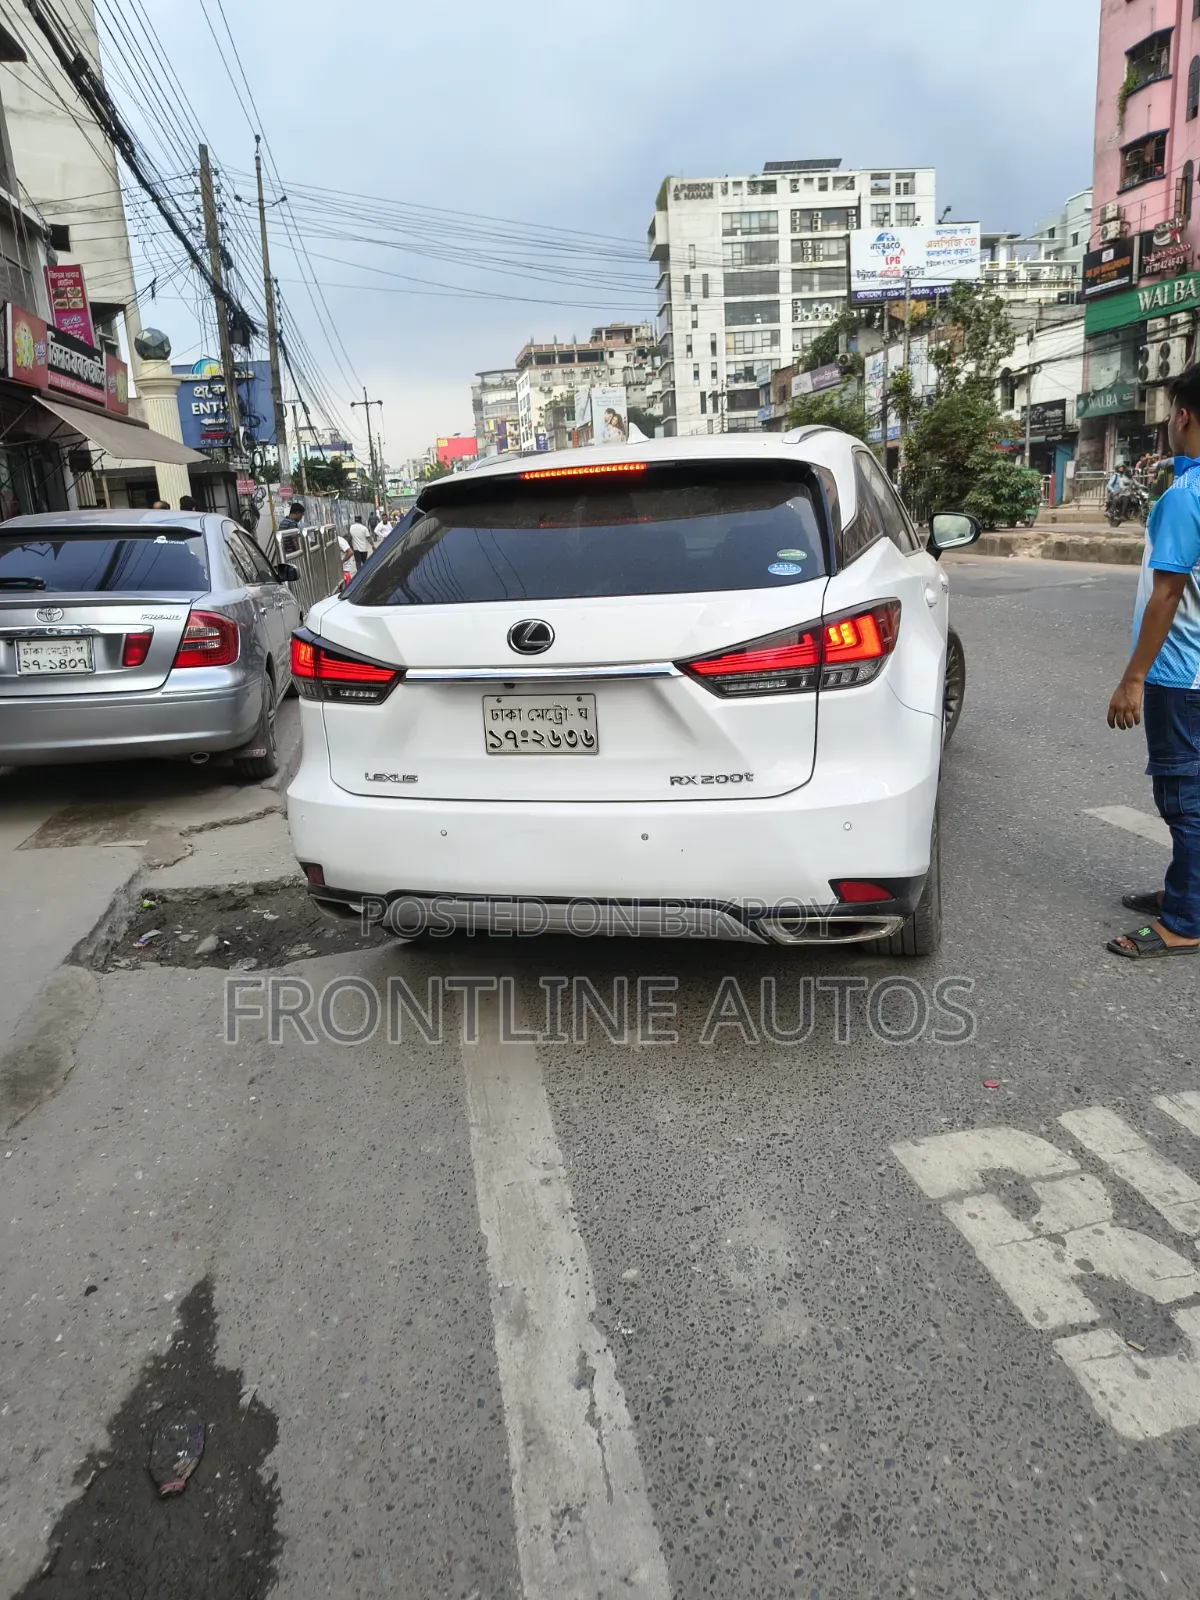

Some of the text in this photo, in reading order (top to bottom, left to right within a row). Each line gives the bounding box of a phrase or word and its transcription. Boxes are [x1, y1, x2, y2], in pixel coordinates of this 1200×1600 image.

[925, 236, 977, 248] এলপিজি তে
[885, 256, 900, 265] LPG
[1138, 278, 1197, 315] WALBA
[1088, 393, 1118, 410] WALBA
[140, 613, 182, 621] PREMIO
[22, 647, 43, 656] ঢাকা
[22, 658, 88, 670] ২৭-১৪০৭
[490, 706, 522, 721] ঢাকা
[488, 729, 596, 748] ১৭-২৬৩৬
[364, 772, 418, 783] LEXUS
